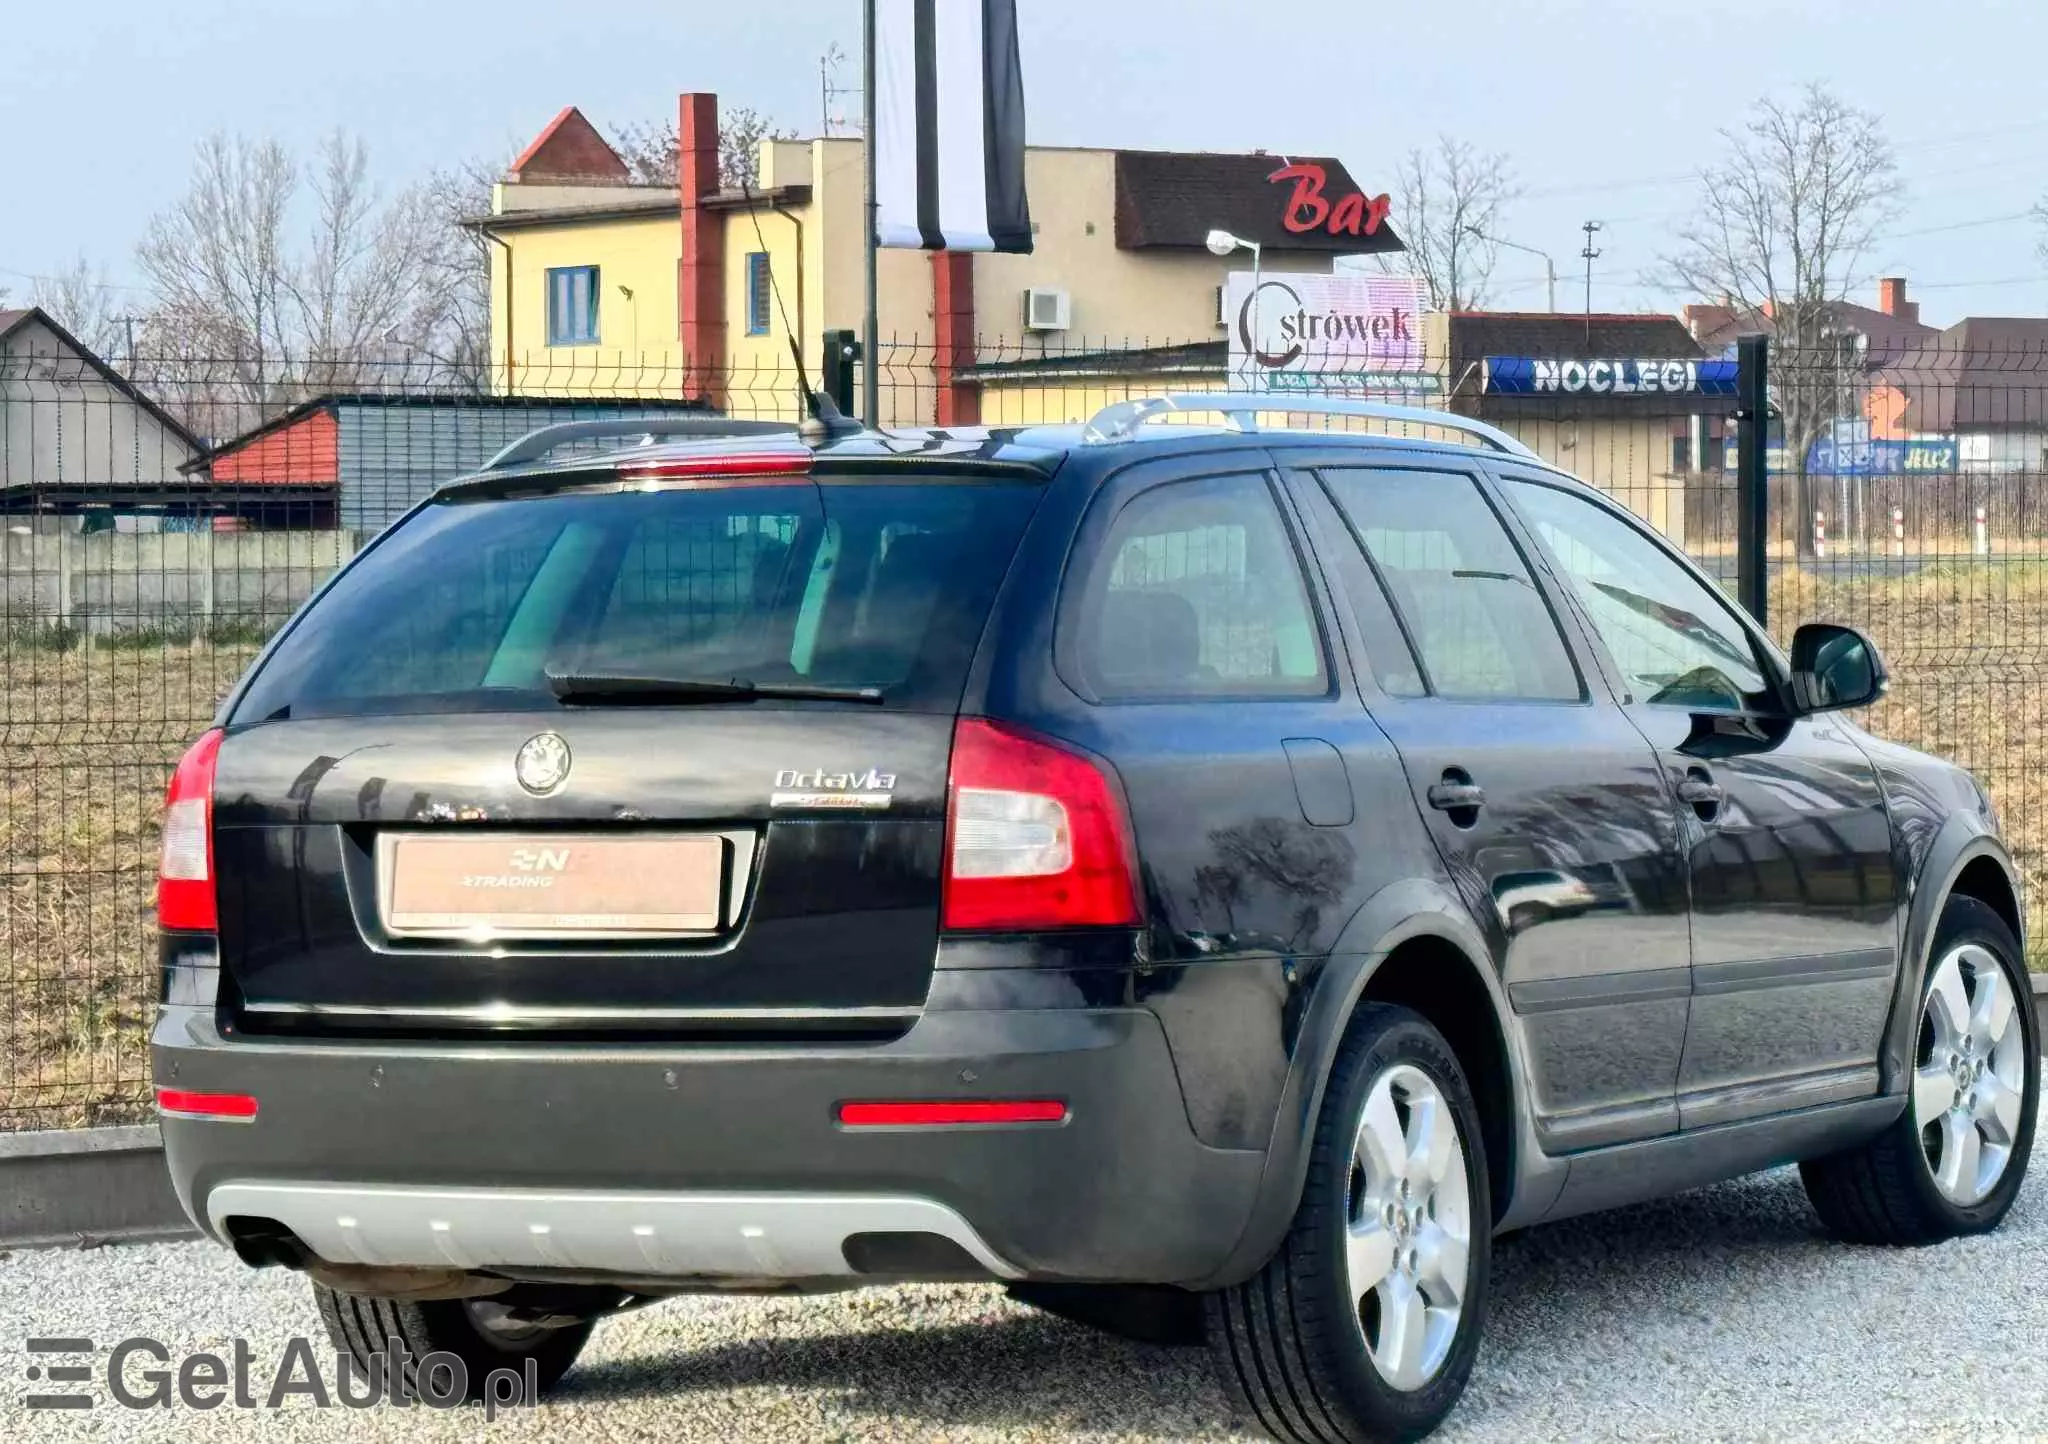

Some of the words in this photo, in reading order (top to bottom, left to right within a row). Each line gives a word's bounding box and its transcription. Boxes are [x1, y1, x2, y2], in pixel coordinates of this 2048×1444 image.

[1266, 163, 1391, 235] Bar
[1533, 360, 1697, 393] NOCLEGI
[775, 767, 897, 789] Octavia
